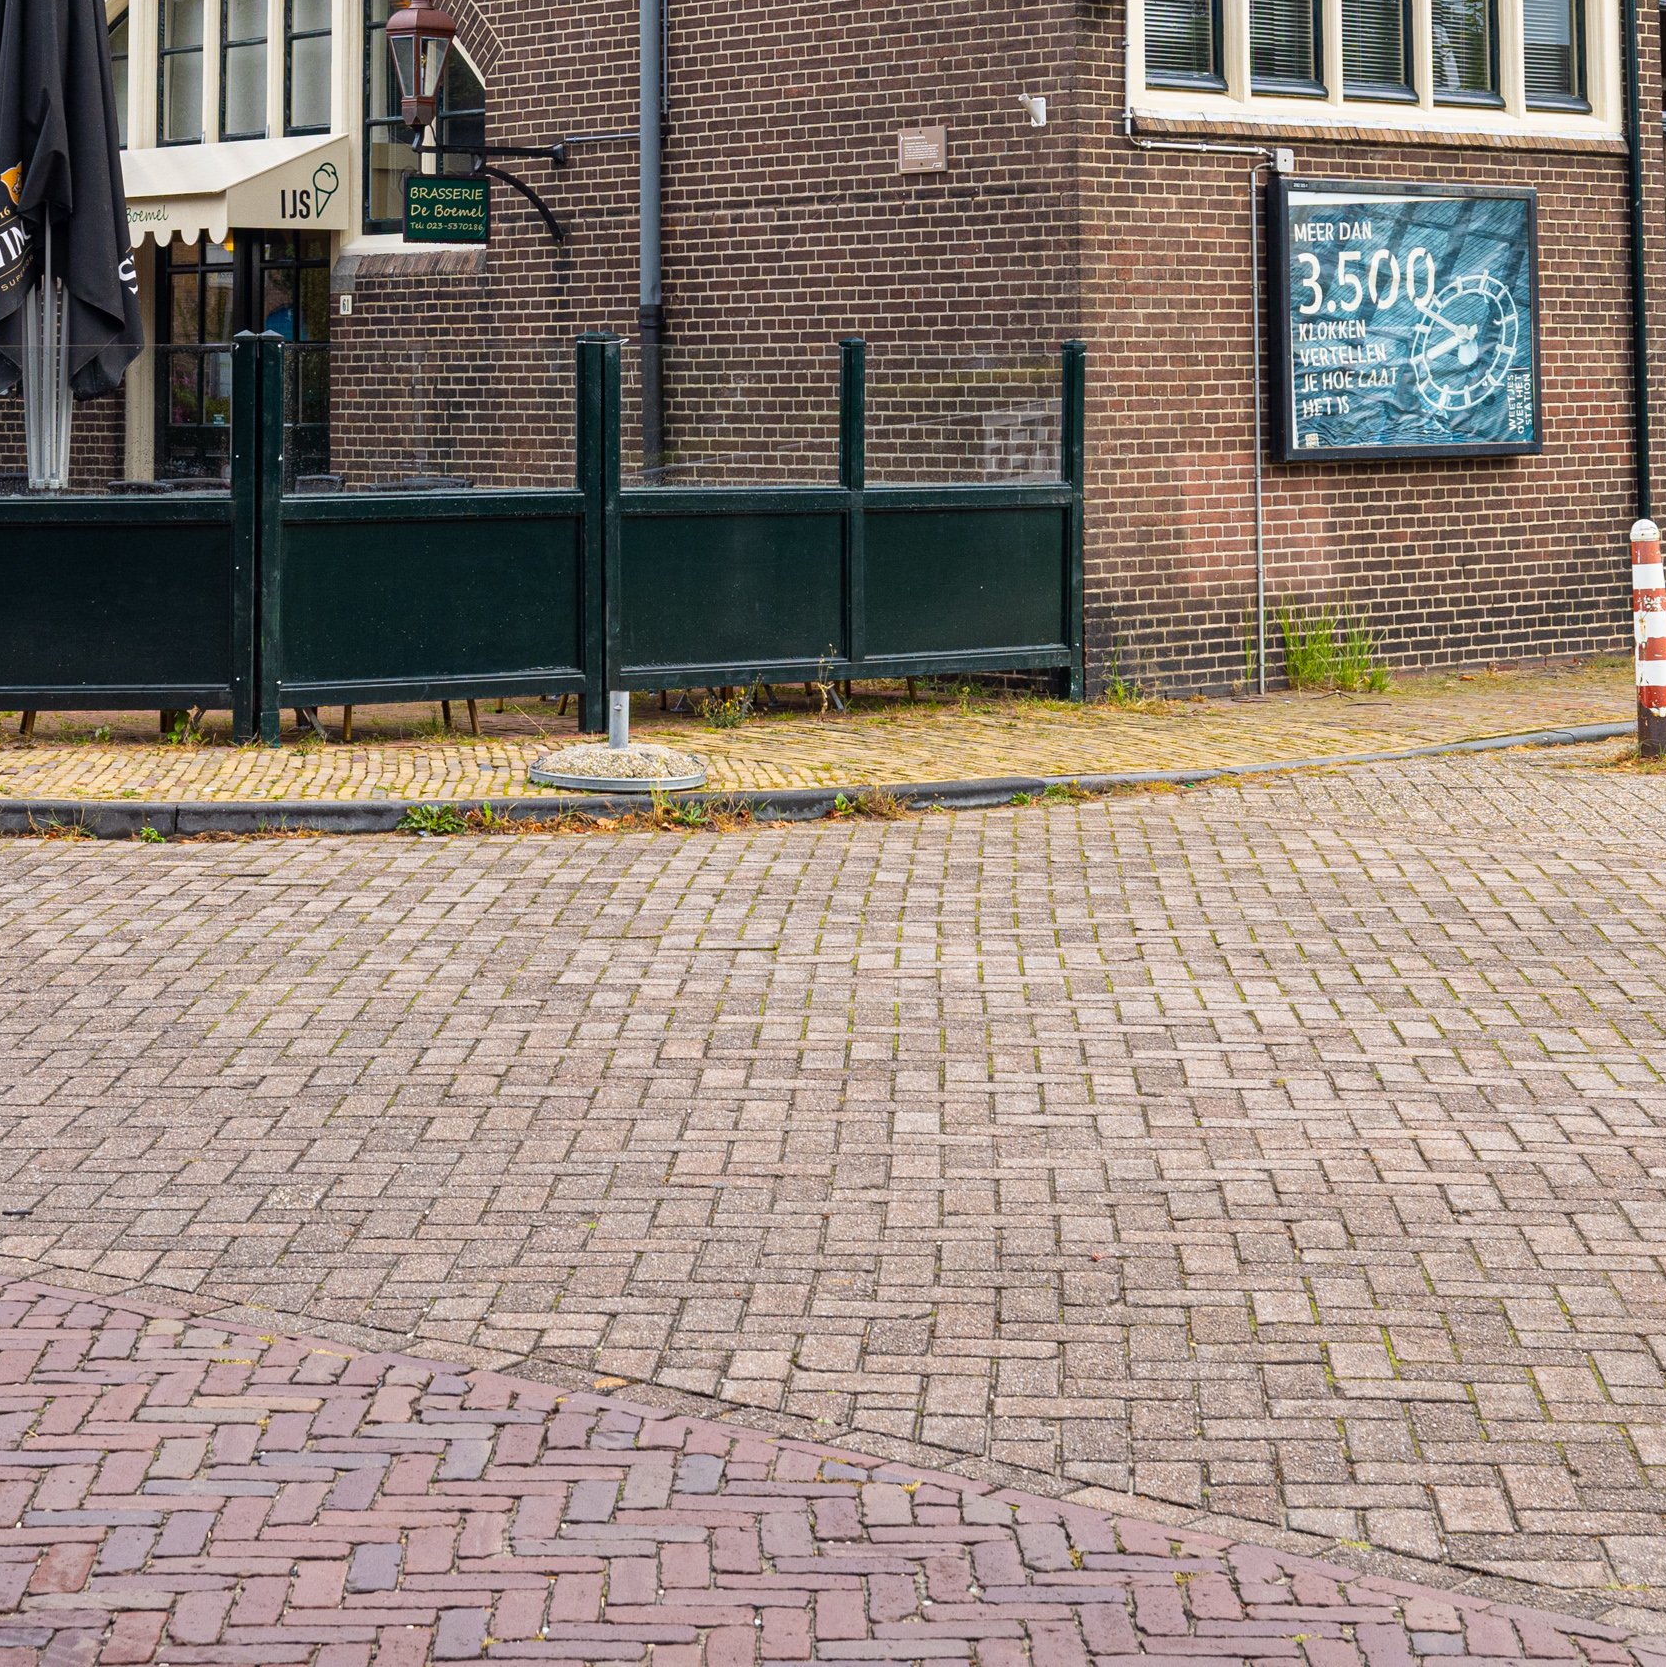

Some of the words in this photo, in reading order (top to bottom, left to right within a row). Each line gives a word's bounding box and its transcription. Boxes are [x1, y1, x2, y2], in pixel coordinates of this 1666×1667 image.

[281, 189, 311, 219] IJS
[410, 187, 484, 201] BRASSERIE
[410, 204, 430, 217] De
[434, 204, 485, 218] Boemel
[426, 222, 484, 231] 023-5370186
[1294, 222, 1334, 242] MEER
[1339, 221, 1372, 241] DAN
[1298, 247, 1435, 315] 3.500
[342, 298, 350, 312] 61
[1299, 319, 1366, 342] KLOKKEN
[1299, 343, 1387, 367] VERTELLEN
[1301, 373, 1318, 393] JE
[1322, 370, 1355, 391] HOE
[1358, 367, 1399, 388] LAAT
[1515, 375, 1524, 398] HET
[1302, 397, 1332, 418] HET
[1337, 395, 1350, 414] IS
[1507, 374, 1517, 431] WEETJES
[1523, 374, 1533, 426] STATION
[1516, 401, 1525, 434] OVER
